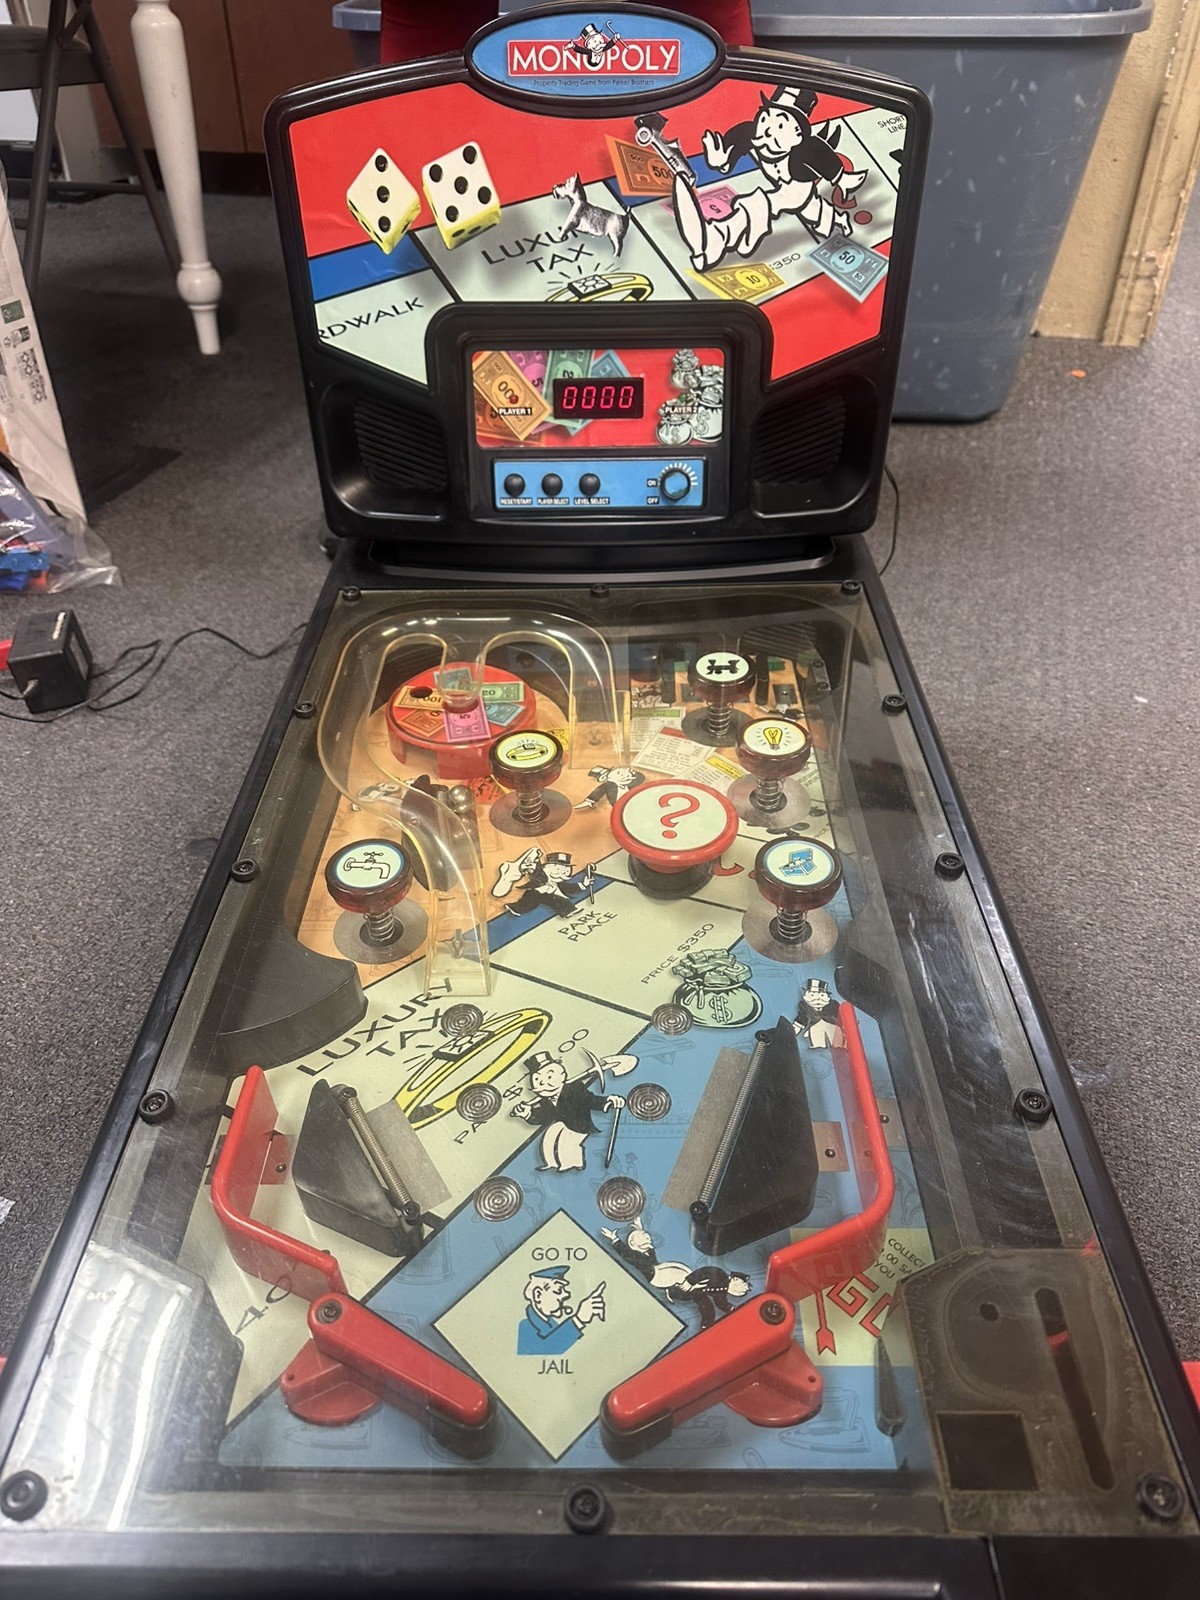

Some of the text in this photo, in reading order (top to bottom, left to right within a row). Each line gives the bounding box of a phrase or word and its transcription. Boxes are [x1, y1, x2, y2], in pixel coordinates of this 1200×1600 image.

[512, 44, 676, 71] MONOPOLY
[533, 79, 558, 87] Property
[559, 79, 579, 87] Trading
[877, 115, 905, 128] SHORT
[887, 122, 906, 134] LINE
[525, 243, 594, 273] TAX
[769, 252, 801, 271] 350
[838, 251, 856, 265] 50
[745, 274, 760, 285] 10
[562, 386, 635, 410] 0000
[665, 406, 692, 414] PLAYER
[558, 909, 601, 936] PARK
[568, 912, 617, 942] PLACE
[641, 923, 714, 984] PRICE $350
[366, 1007, 443, 1057] TAX
[454, 1120, 488, 1144] PA
[531, 1247, 588, 1261] GO TO
[888, 1238, 926, 1268] COLLECT
[874, 1260, 896, 1279] YOU
[538, 1359, 574, 1375] JAIL
